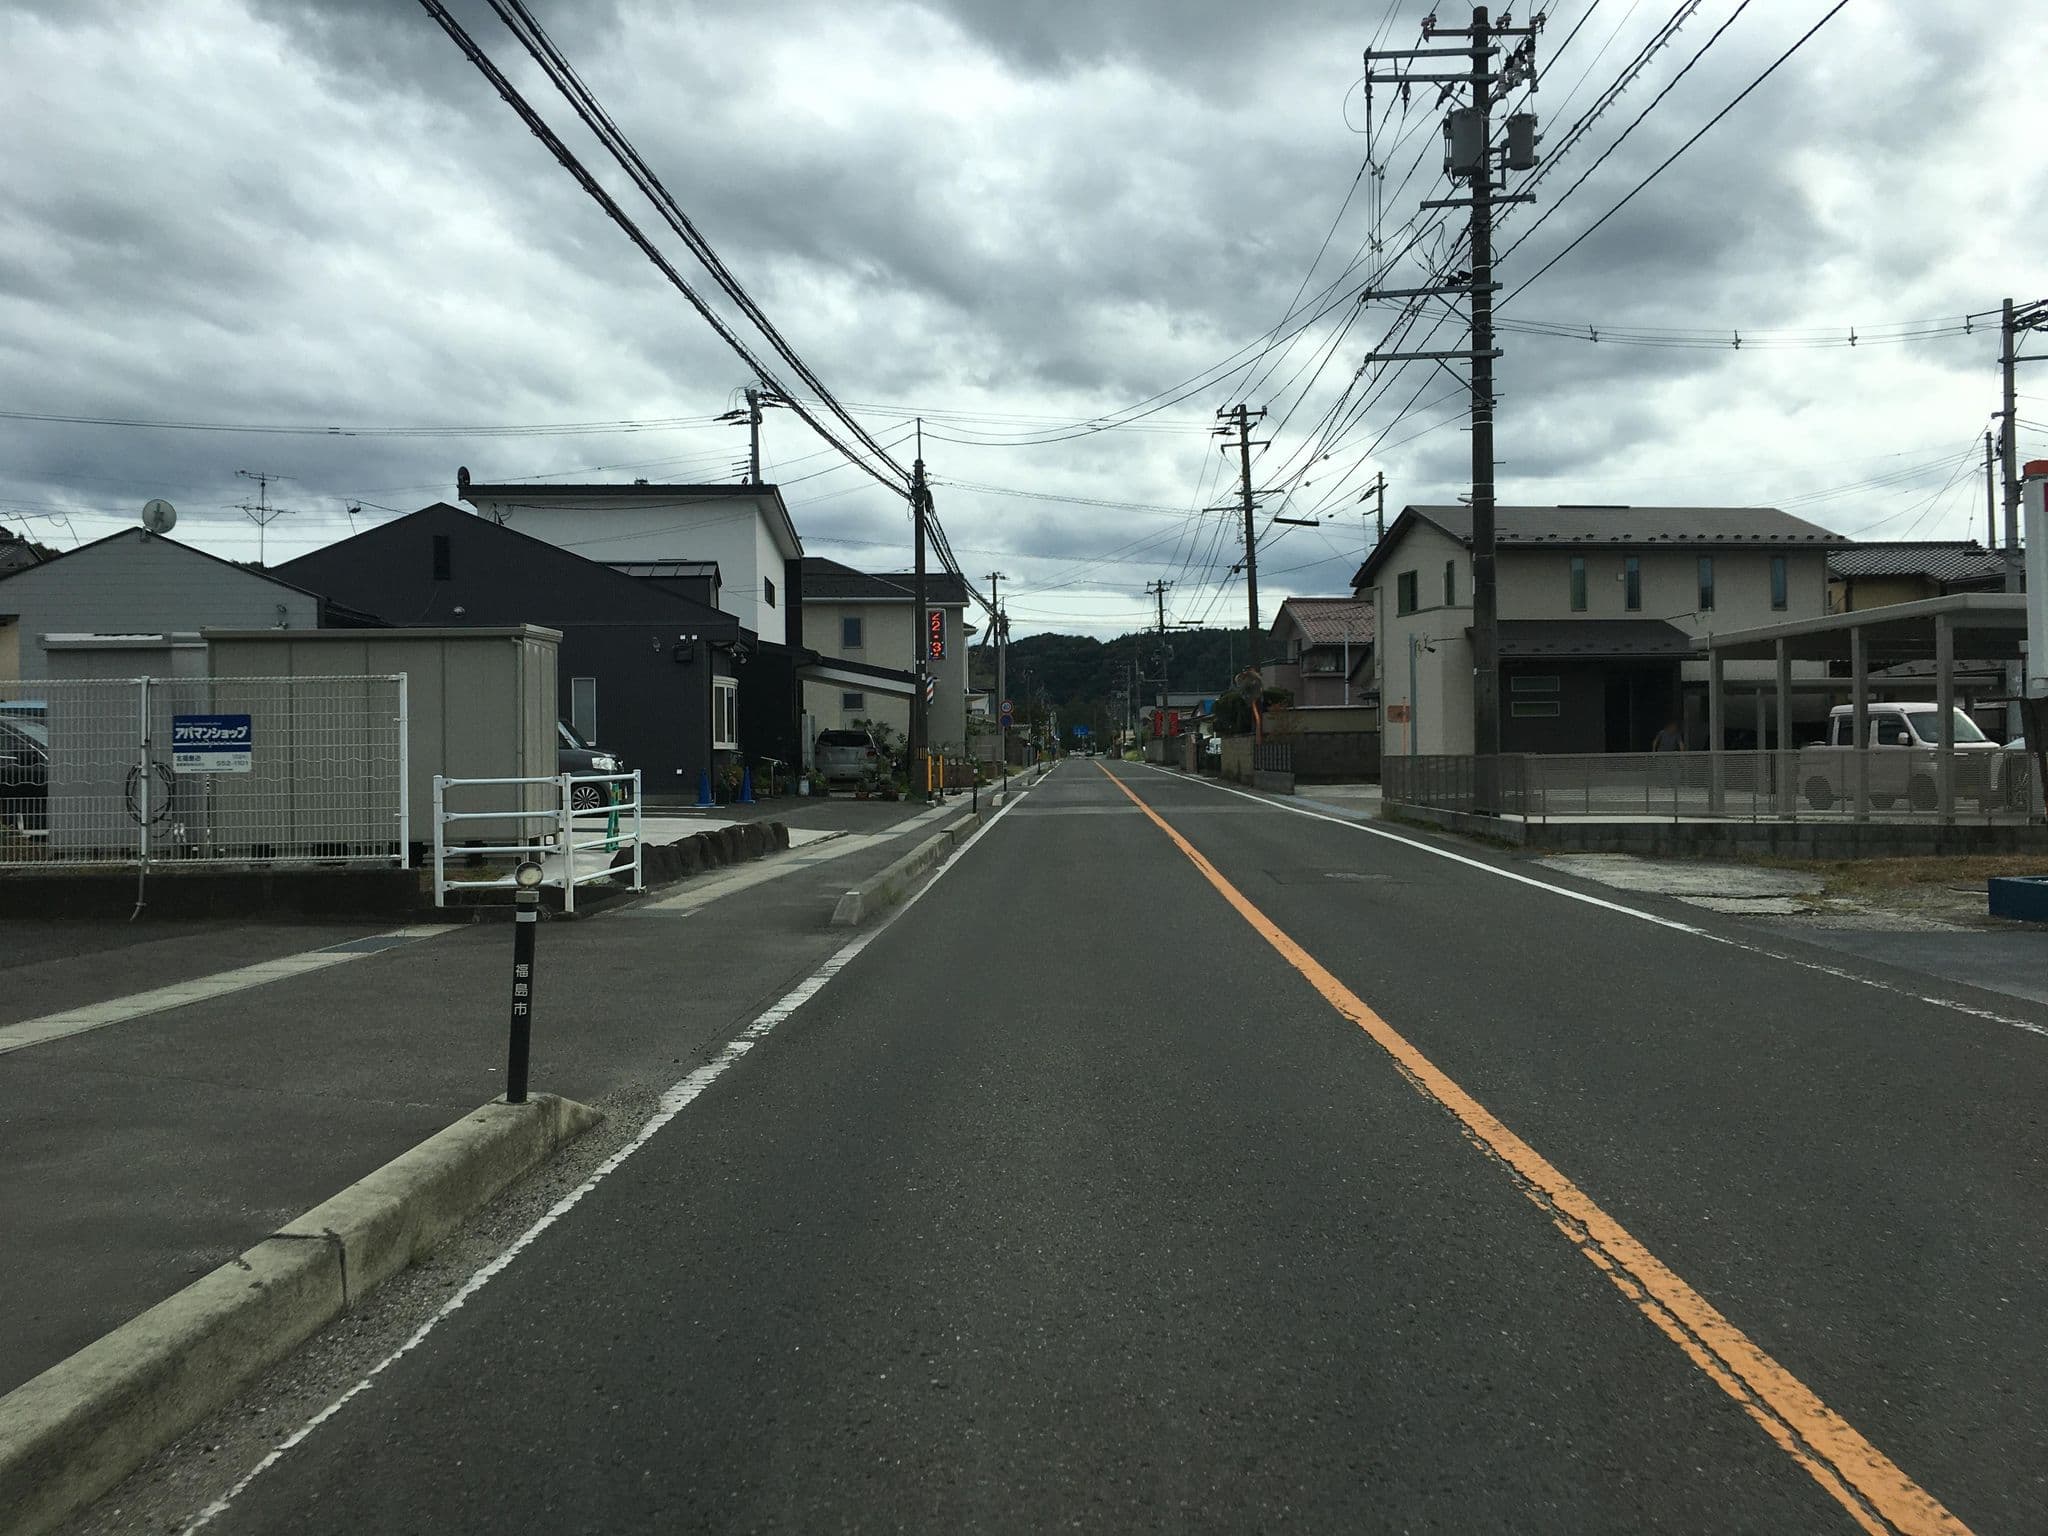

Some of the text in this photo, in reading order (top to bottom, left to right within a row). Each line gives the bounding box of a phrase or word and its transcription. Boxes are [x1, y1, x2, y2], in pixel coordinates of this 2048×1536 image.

[175, 726, 248, 739] アパマンショップ
[514, 963, 529, 1016] 福島市
